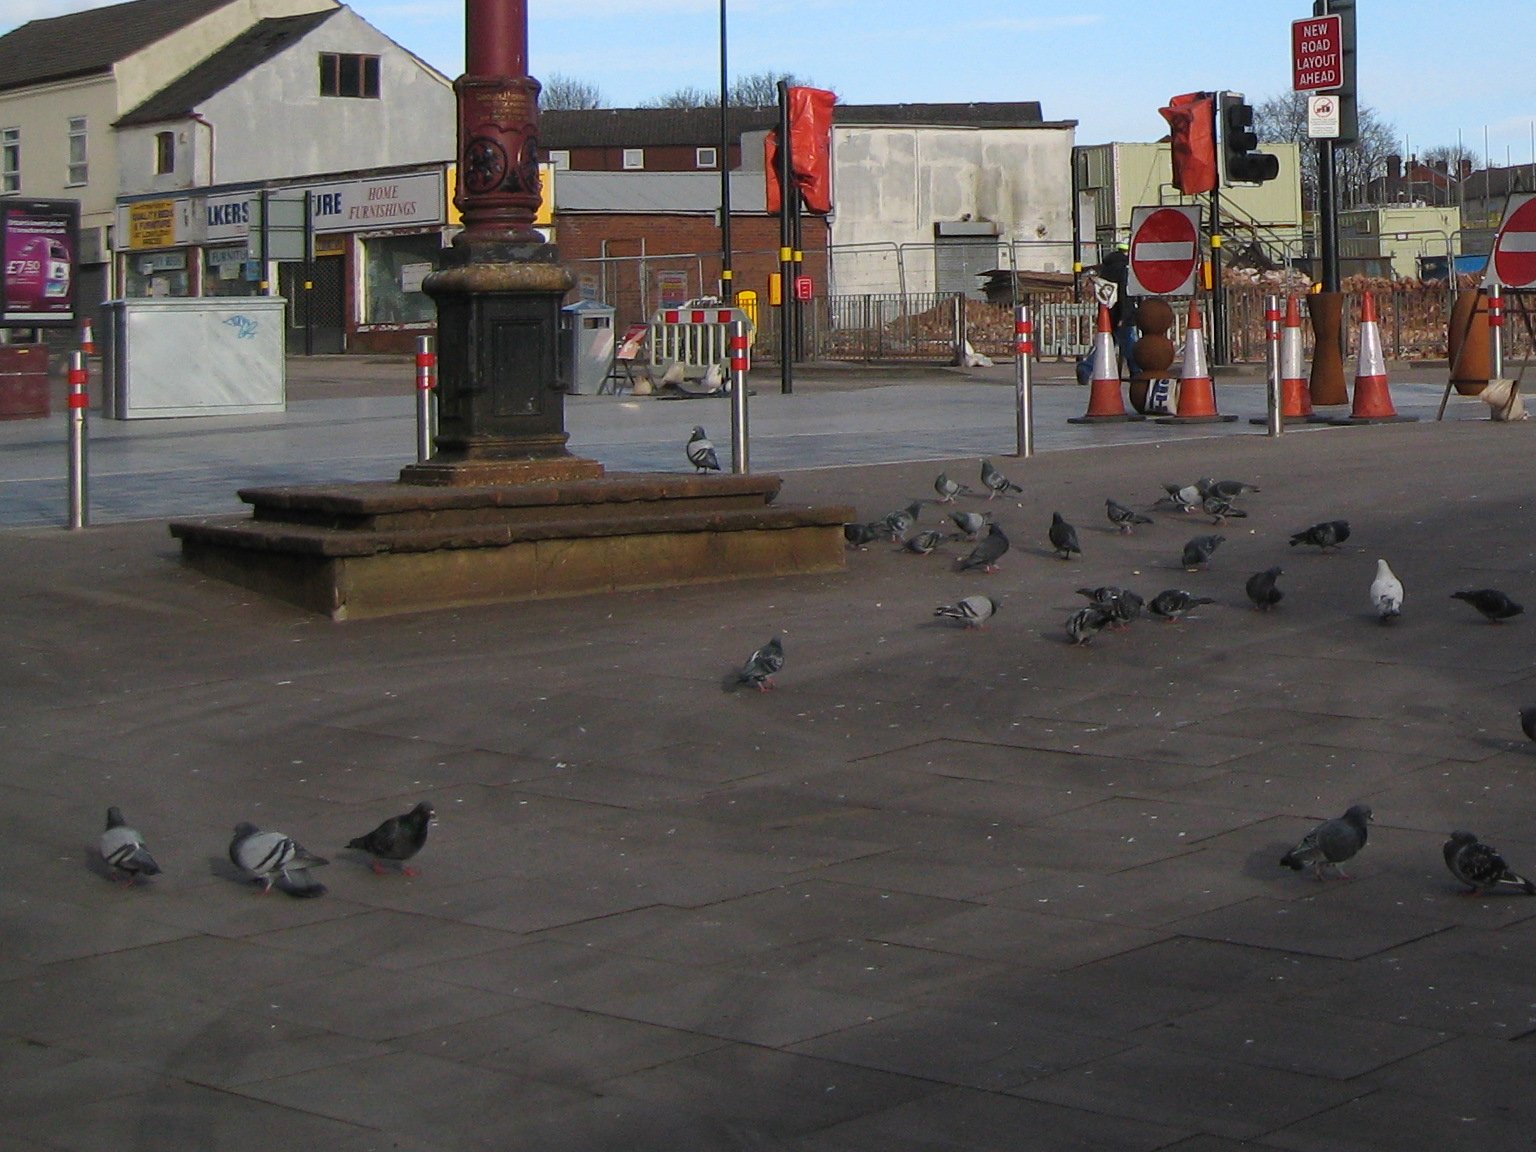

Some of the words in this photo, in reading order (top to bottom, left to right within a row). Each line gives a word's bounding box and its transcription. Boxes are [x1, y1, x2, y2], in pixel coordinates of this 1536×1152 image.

[1303, 23, 1328, 37] NEW
[1301, 39, 1331, 54] ROAD
[1297, 54, 1337, 70] LAYOUT
[1299, 70, 1336, 85] AHEAD
[368, 184, 399, 201] HOME
[348, 201, 417, 220] FURNISHINGS
